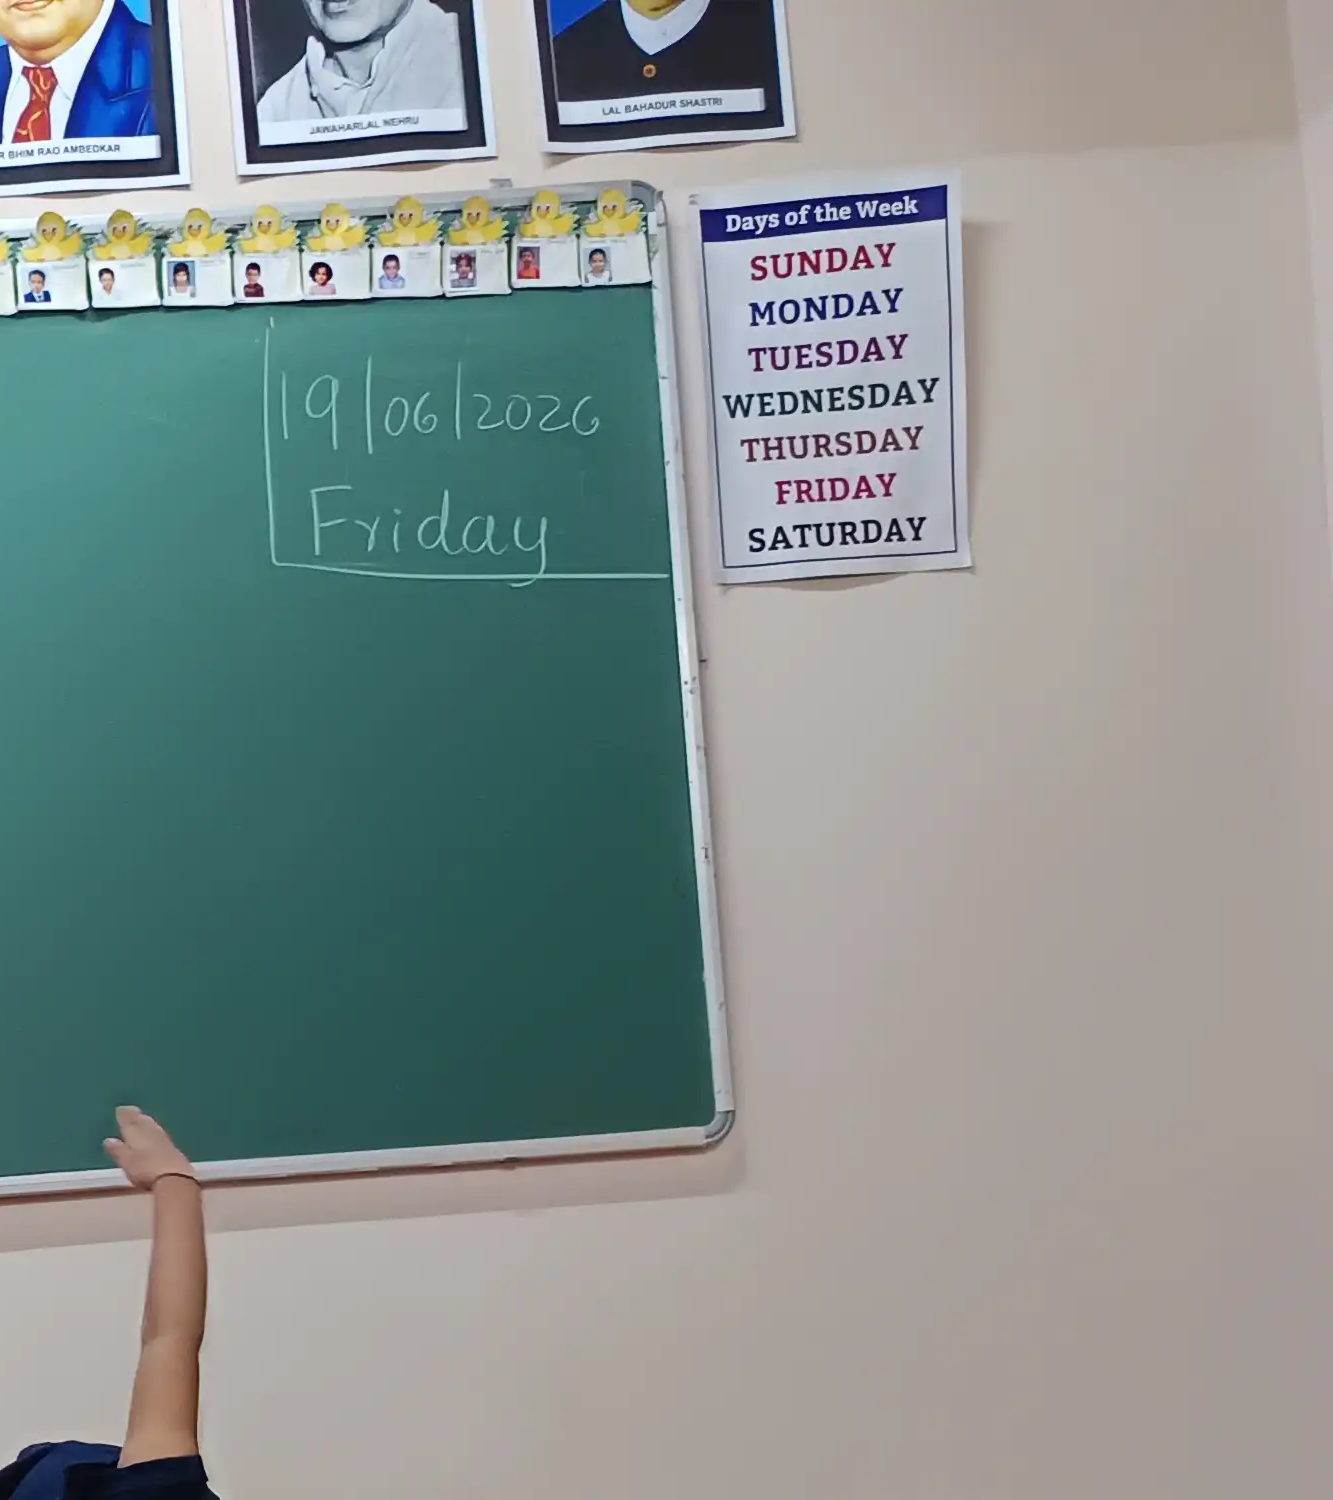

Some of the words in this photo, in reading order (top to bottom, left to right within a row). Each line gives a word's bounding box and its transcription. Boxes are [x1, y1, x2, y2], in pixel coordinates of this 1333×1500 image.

[602, 107, 621, 115] LAL
[624, 100, 676, 113] BAHADUR
[679, 97, 723, 107] SHASTRI
[309, 120, 381, 135] JAWAHARLAL
[382, 116, 419, 126] NEHRU
[8, 149, 34, 159] BHIM
[37, 146, 60, 156] RAO
[63, 144, 121, 154] AMBEDKAR
[725, 213, 780, 234] Days
[784, 204, 811, 226] of
[814, 203, 851, 223] the
[856, 196, 919, 219] Week
[750, 242, 897, 281] SUNDAY
[748, 288, 904, 327] MONDAY
[747, 333, 909, 372] TUESDAY
[722, 377, 940, 419] WEDNESDAY
[740, 425, 924, 463] THURSDAY
[774, 473, 897, 505] FRIDAY
[310, 486, 547, 587] Friday
[748, 516, 927, 553] SATURDAY
